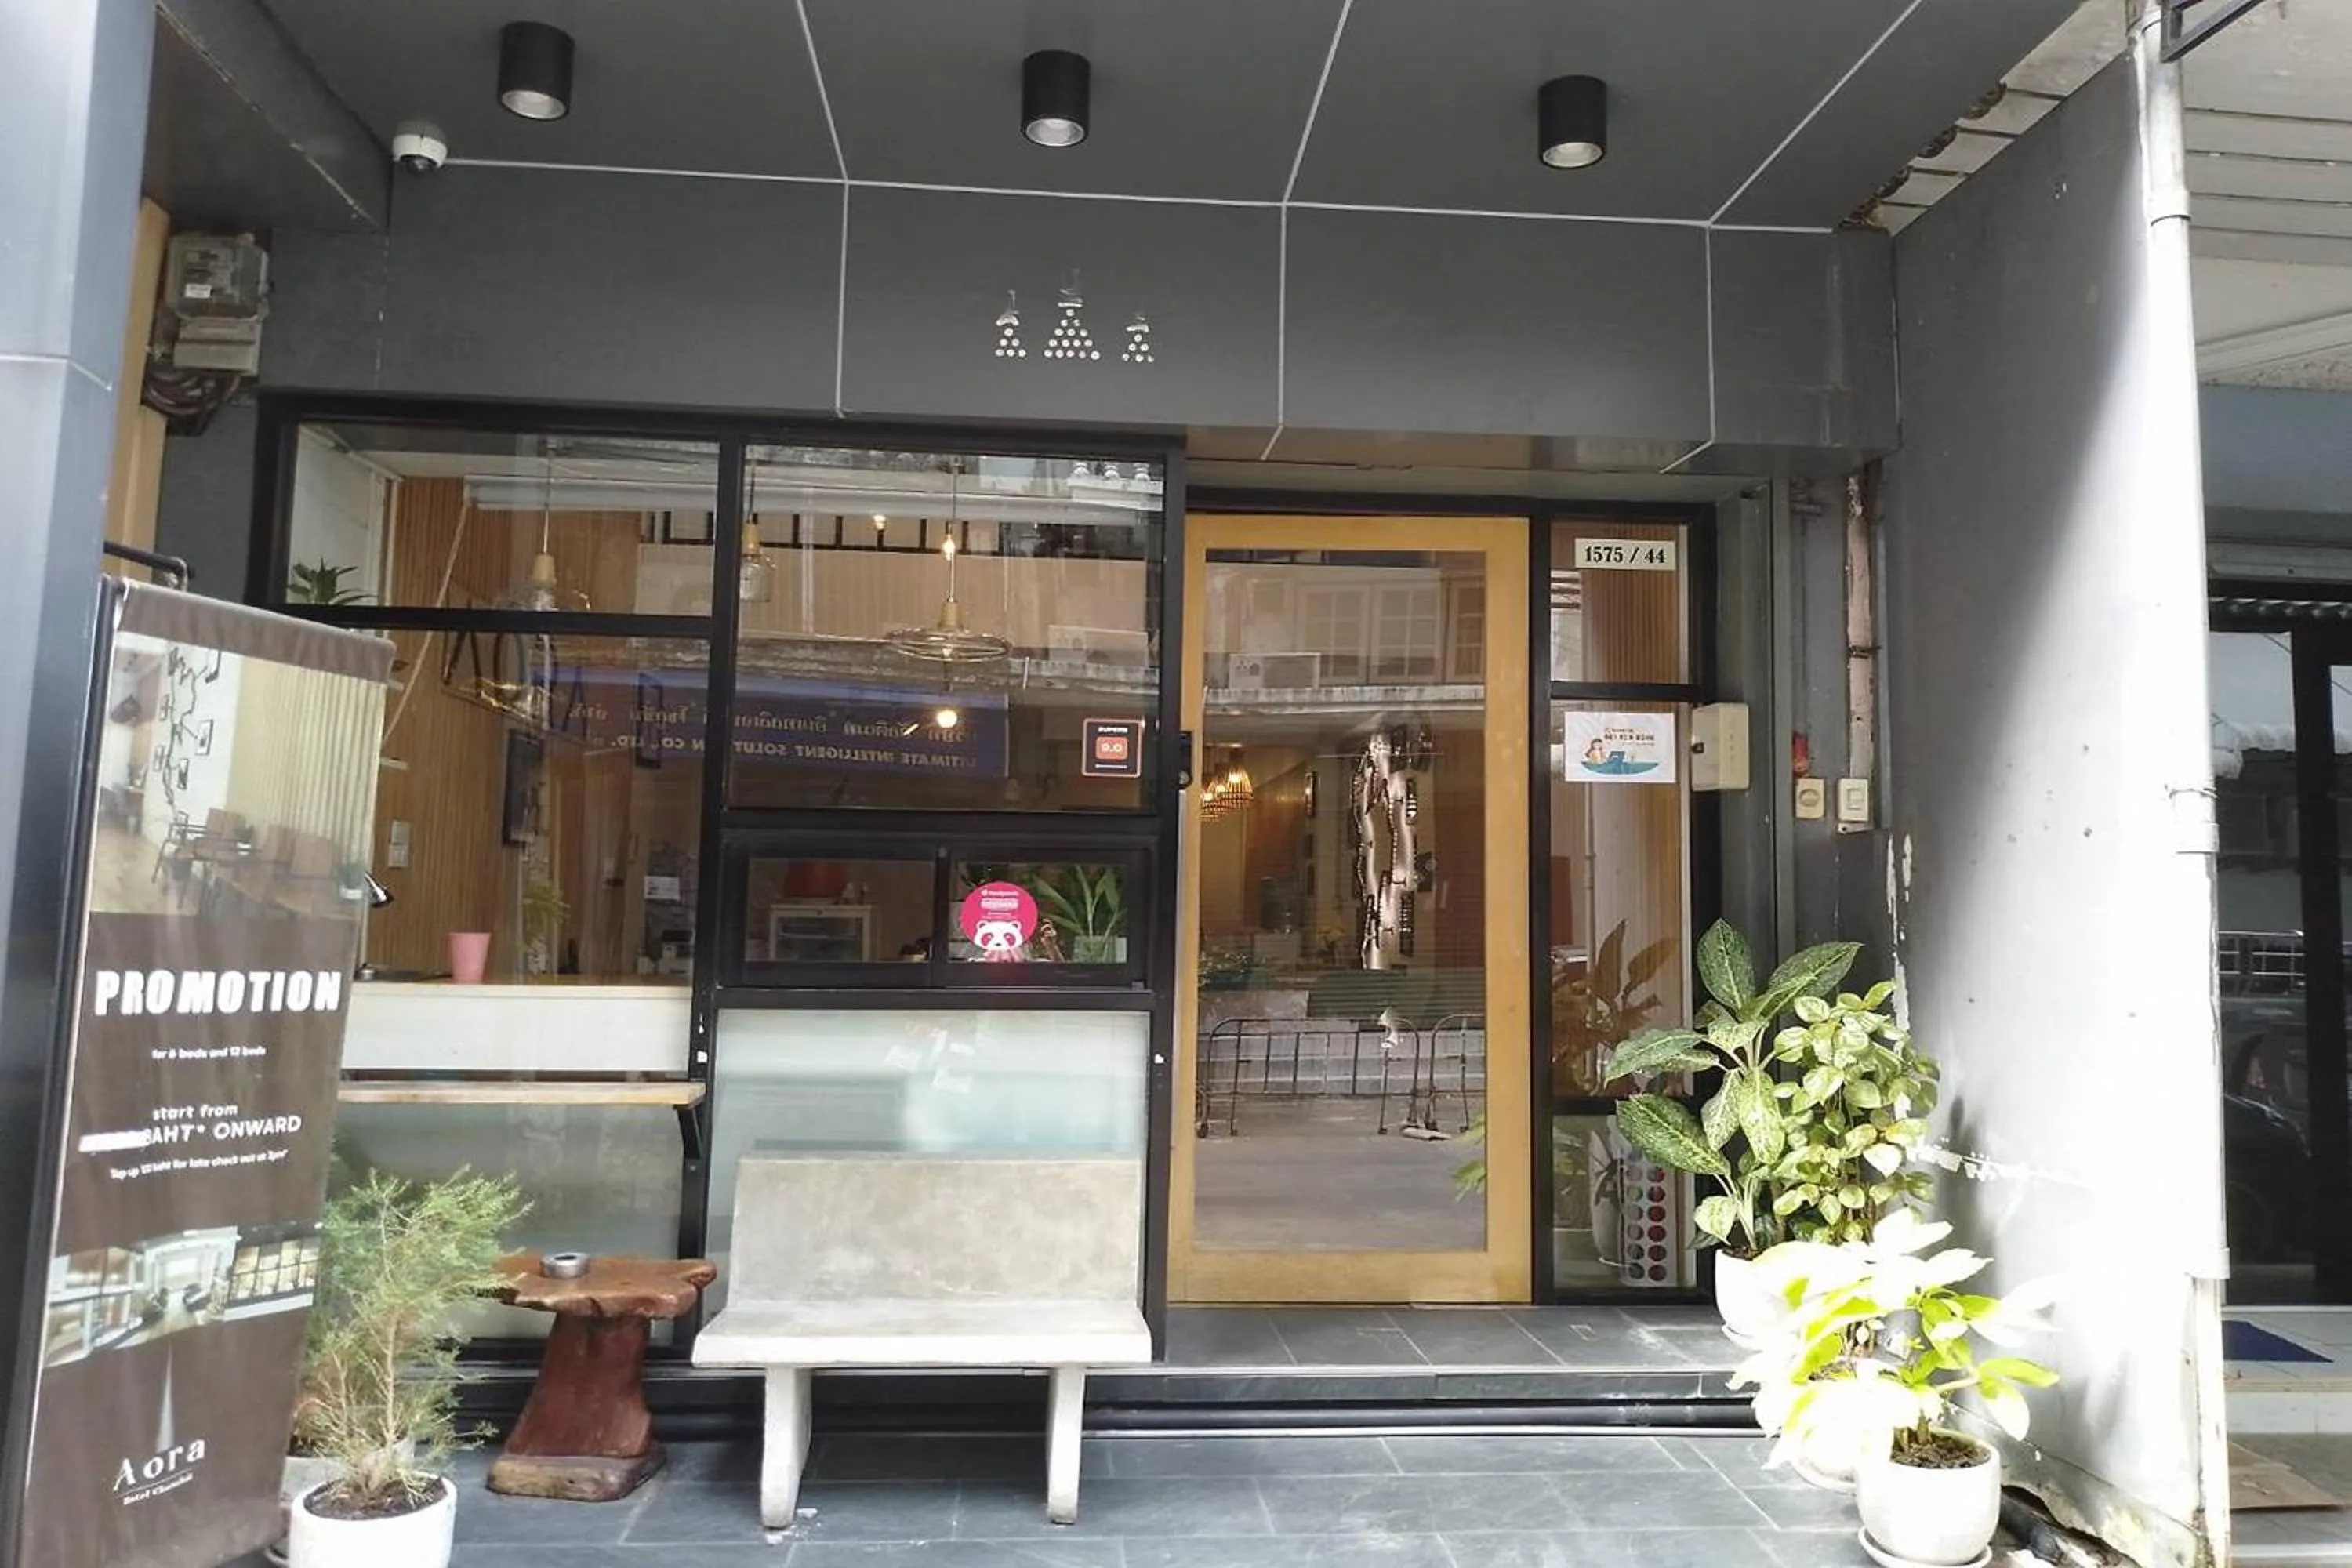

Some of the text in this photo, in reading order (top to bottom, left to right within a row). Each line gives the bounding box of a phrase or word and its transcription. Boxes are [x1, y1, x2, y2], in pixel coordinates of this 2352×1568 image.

[1584, 546, 1665, 564] 1575 / 44
[95, 970, 342, 1016] PROMOTION
[153, 1105, 238, 1120] start from
[212, 1116, 302, 1140] ONWARD
[113, 1439, 205, 1491] Aora
